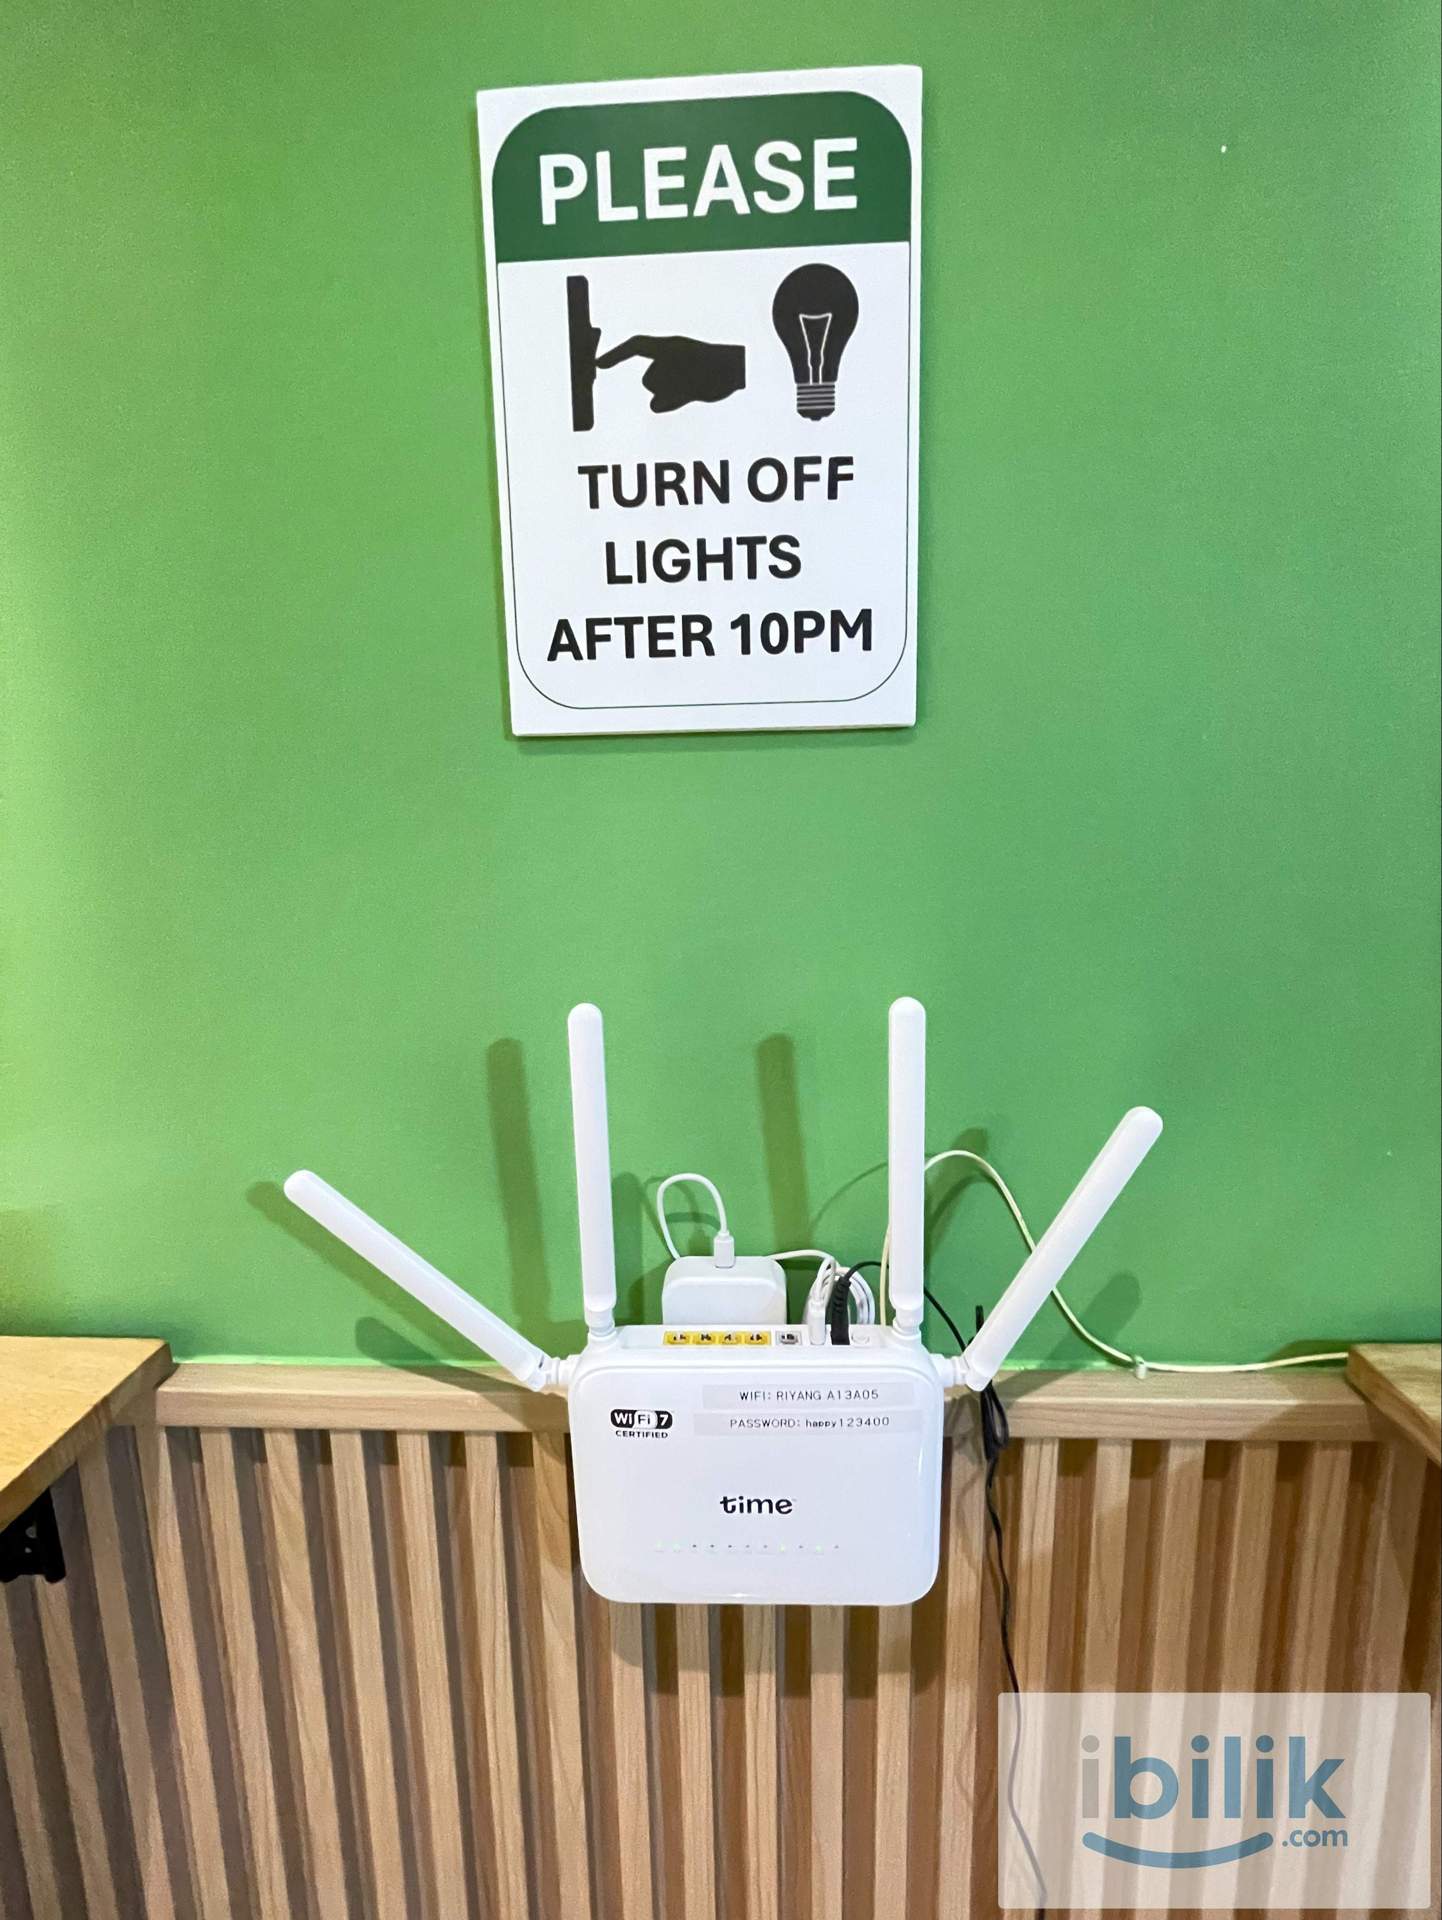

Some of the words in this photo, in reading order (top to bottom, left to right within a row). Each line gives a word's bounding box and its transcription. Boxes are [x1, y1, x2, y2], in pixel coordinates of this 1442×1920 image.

[539, 137, 857, 225] PLEASE
[577, 459, 730, 509] TURN
[747, 455, 854, 503] OFF
[605, 534, 802, 584] LIGHTS
[547, 614, 715, 662] AFTER
[730, 608, 872, 655] 10PM
[739, 1390, 771, 1401] WIFI:
[776, 1390, 821, 1401] RIYANG
[827, 1388, 879, 1401] A13A05
[659, 1414, 669, 1426] 7
[730, 1418, 800, 1429] PASSWORD:
[805, 1416, 889, 1429] happy123400
[615, 1430, 668, 1438] CERTIFIED
[720, 1496, 792, 1514] time
